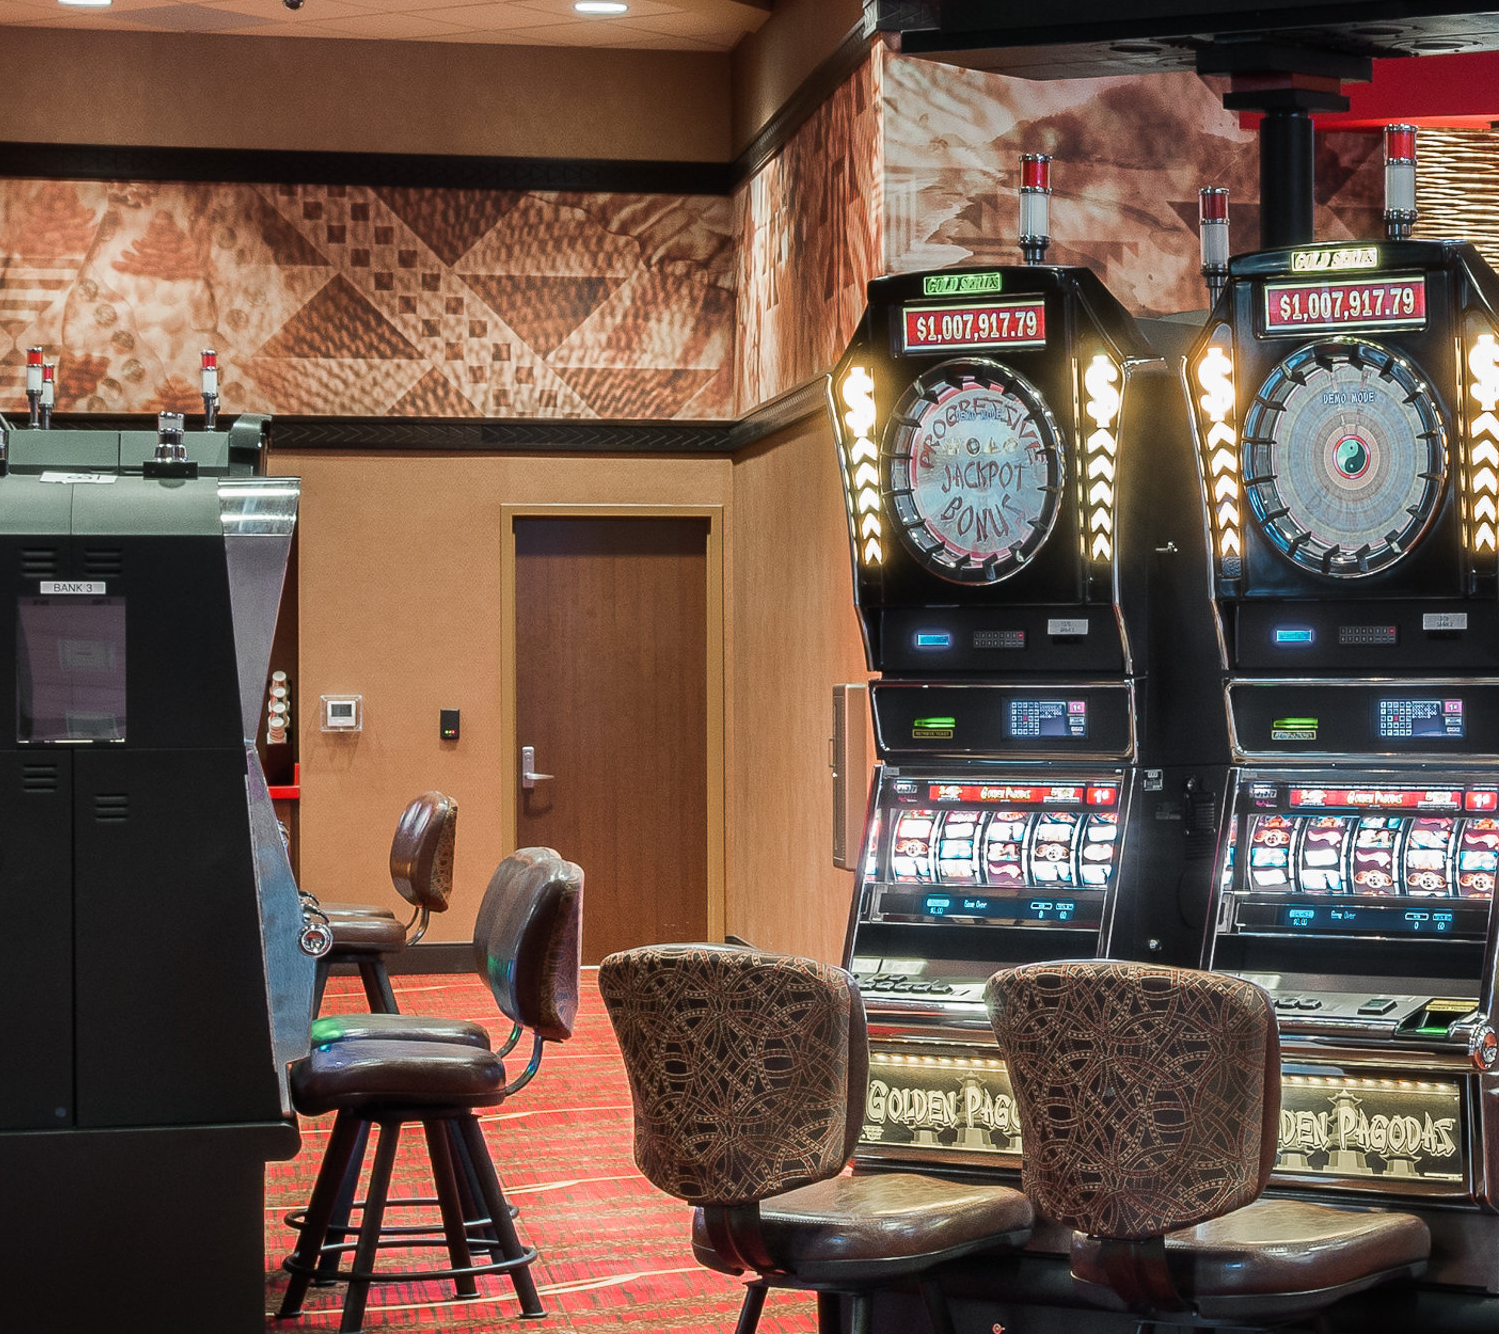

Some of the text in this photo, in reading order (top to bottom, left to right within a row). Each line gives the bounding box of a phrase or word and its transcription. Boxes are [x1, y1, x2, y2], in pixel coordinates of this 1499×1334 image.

[1279, 287, 1415, 323] $1,007,917.79
[916, 310, 1038, 343] $1,007,917.79
[1323, 392, 1375, 404] DEMO MODE
[941, 460, 1029, 494] JACKPOT
[941, 493, 1026, 543] BONUS
[53, 583, 93, 593] BANK 3
[866, 1079, 1022, 1132] GOLDEN PAGO
[1278, 1105, 1457, 1158] DEN PAGODAS
